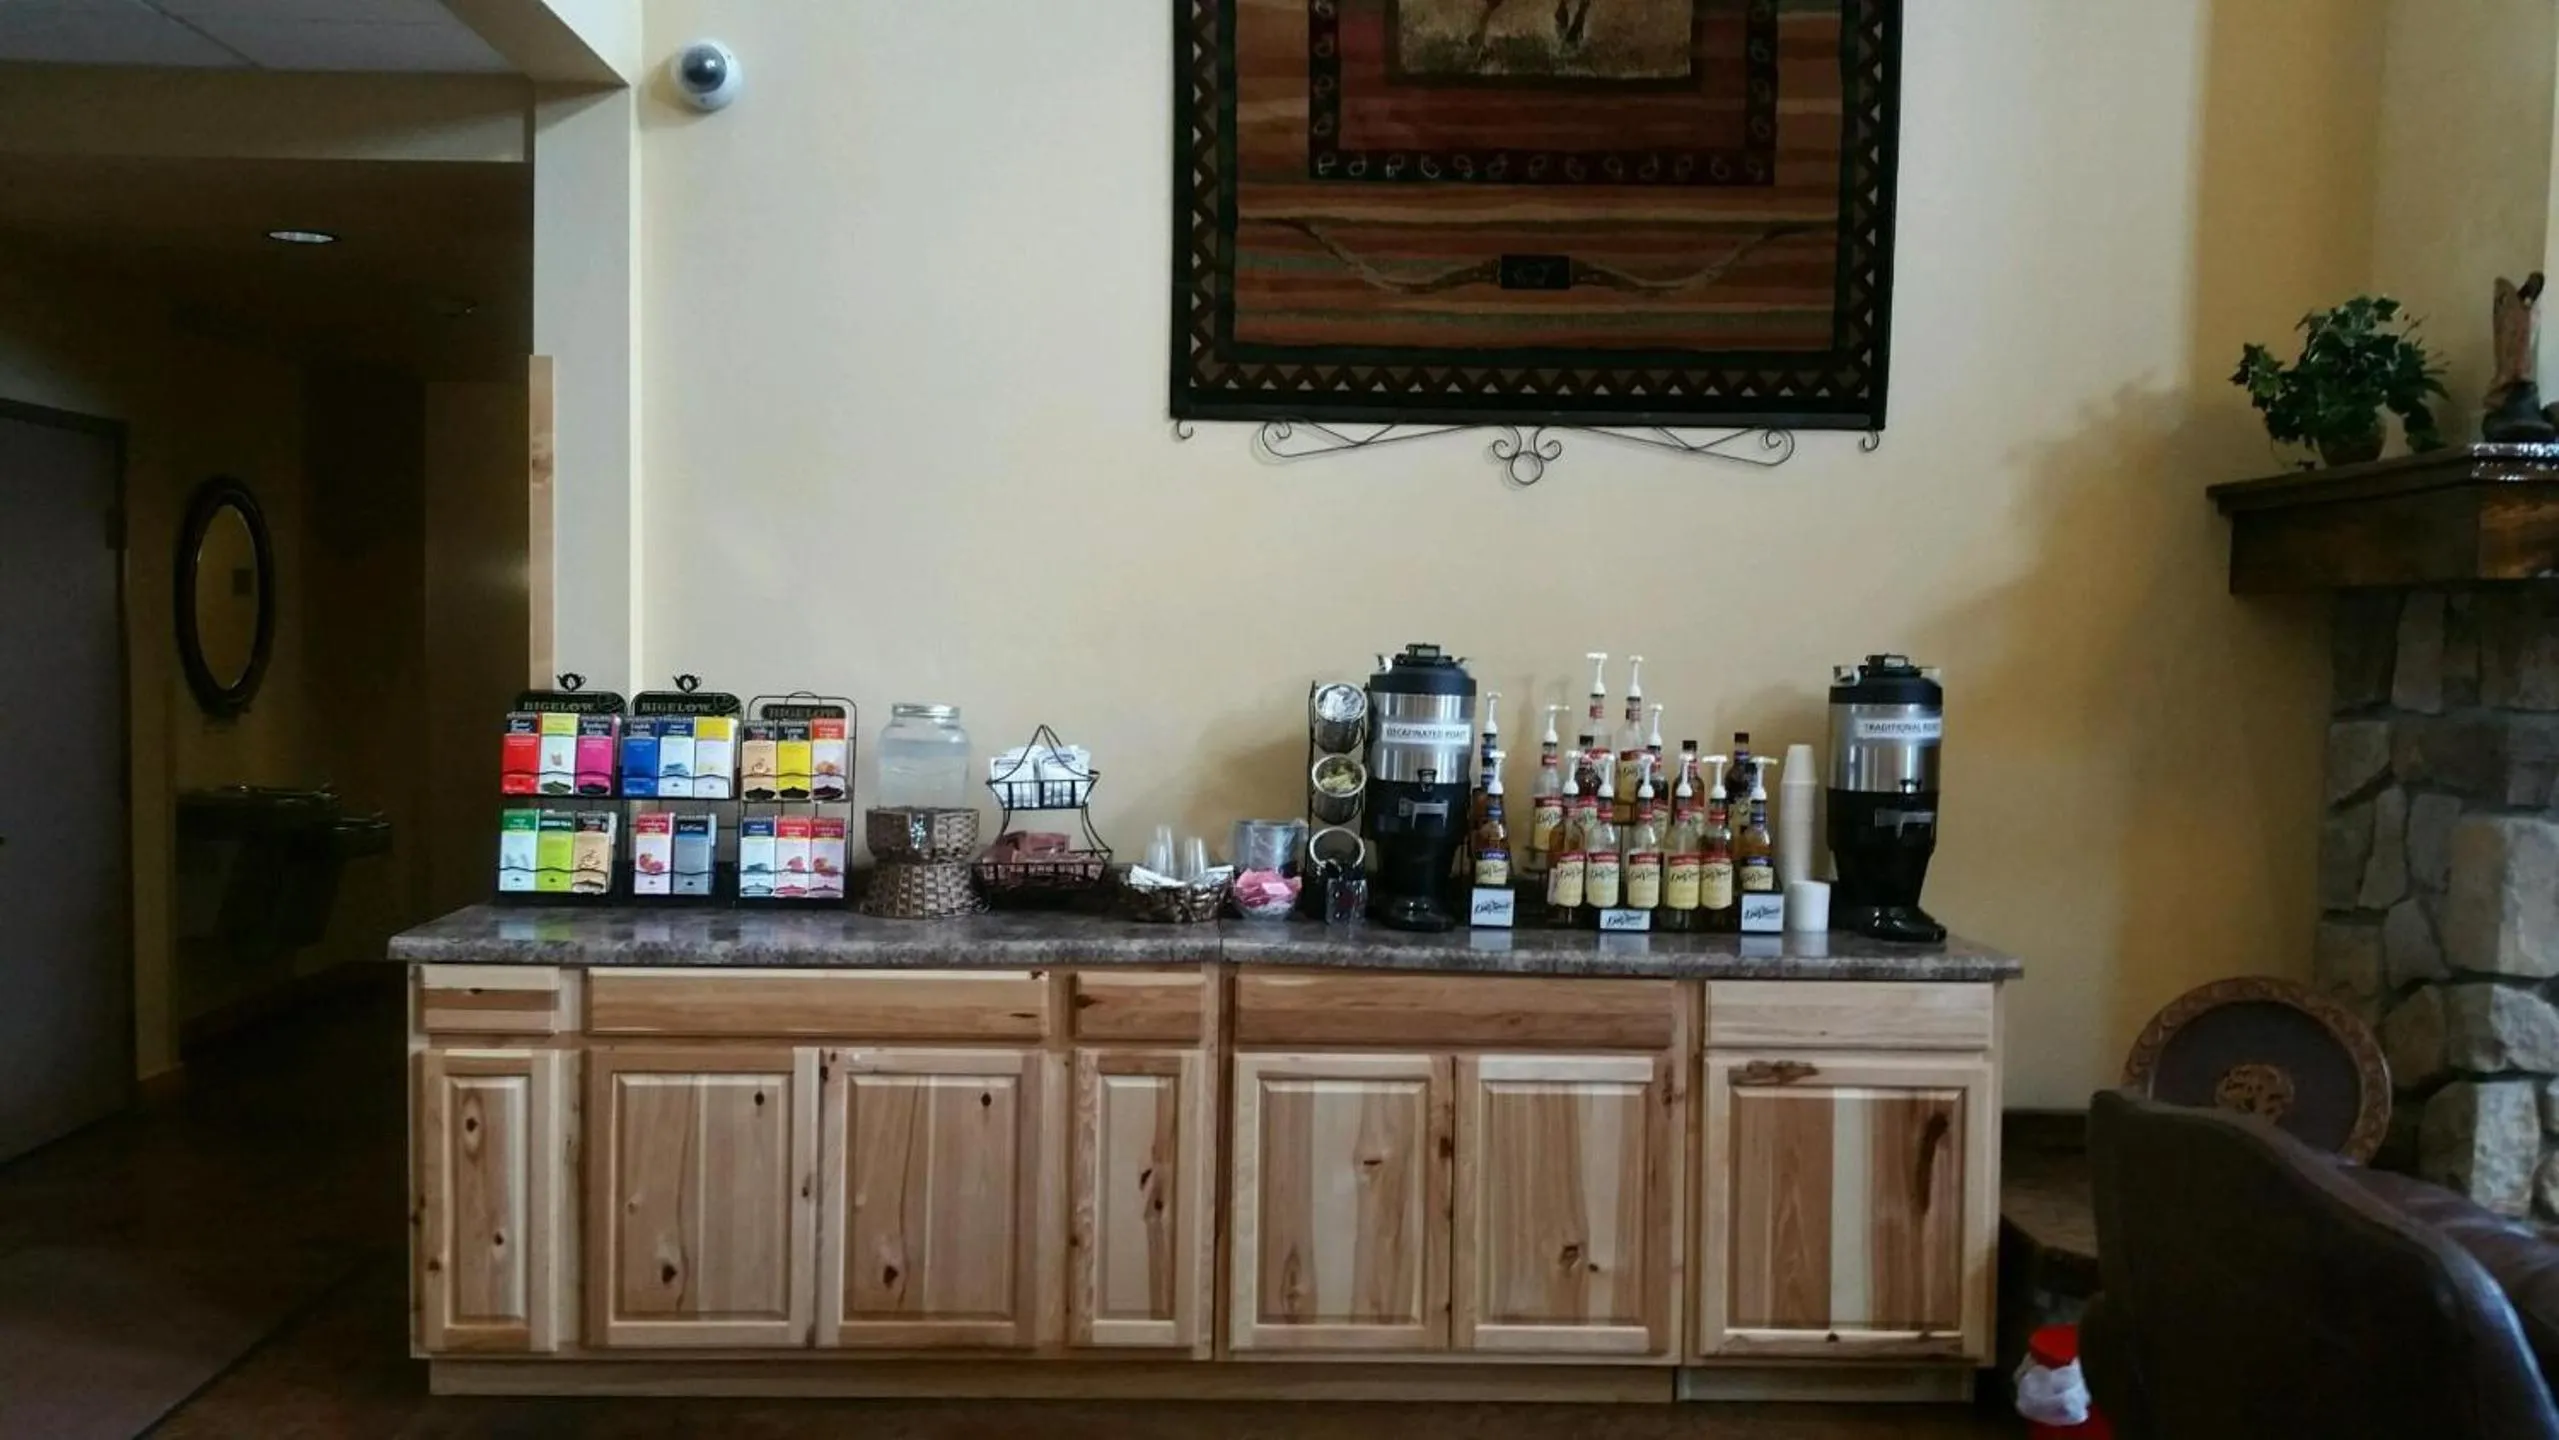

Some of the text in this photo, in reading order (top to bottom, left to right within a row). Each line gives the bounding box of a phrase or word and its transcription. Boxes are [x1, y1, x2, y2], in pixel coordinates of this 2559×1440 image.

[524, 701, 594, 713] BIGELOW
[641, 702, 709, 713] BIGELOW
[1864, 722, 1921, 734] TRADITIONAL
